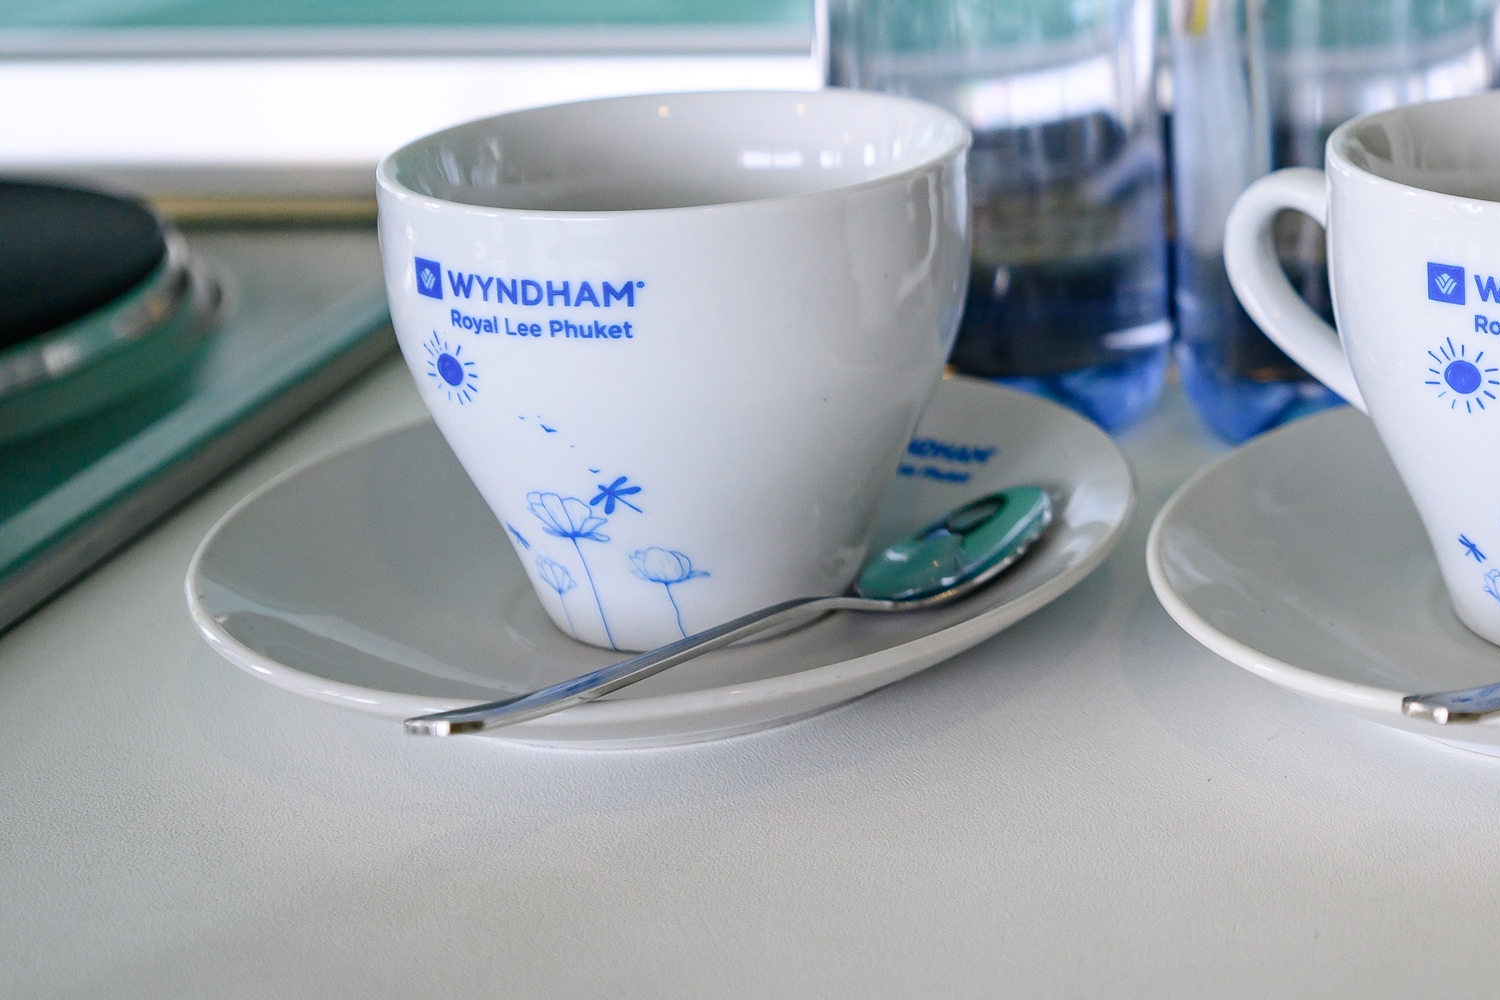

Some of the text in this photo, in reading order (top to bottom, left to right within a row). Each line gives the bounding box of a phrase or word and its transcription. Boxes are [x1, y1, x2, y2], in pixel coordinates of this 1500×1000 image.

[450, 308, 634, 340] Royal Lee Phuket
